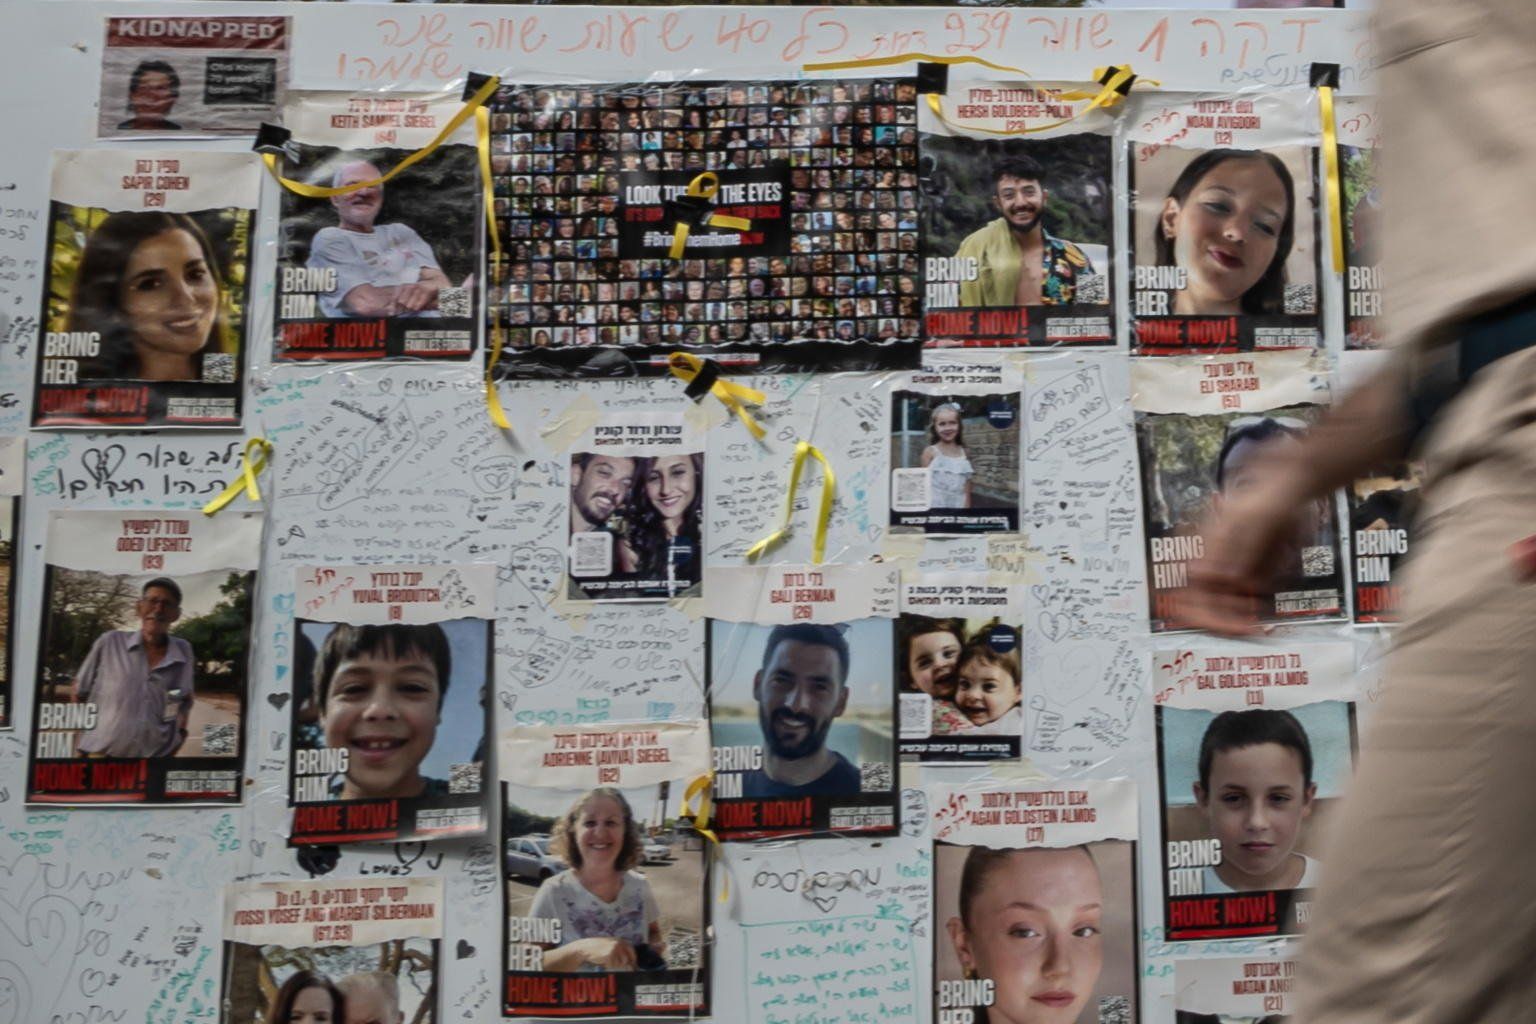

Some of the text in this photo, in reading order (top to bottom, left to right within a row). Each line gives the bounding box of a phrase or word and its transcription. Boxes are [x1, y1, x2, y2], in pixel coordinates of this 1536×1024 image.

[117, 20, 277, 41] KIDNAPPED
[716, 15, 771, 53] 40
[331, 115, 360, 129] KEITH
[957, 105, 1073, 119] HERSH GOLDBERG-POLIN
[1186, 116, 1214, 129] NOAM
[122, 176, 190, 190] SAPIR COHEN
[625, 182, 782, 205] LOOK THE THE EYES
[280, 267, 337, 293] BRING
[925, 257, 979, 282] BRING
[1135, 266, 1187, 290] BRING
[280, 294, 316, 319] HIM
[925, 283, 960, 308] HIM
[1135, 291, 1168, 316] HER
[332, 319, 387, 349] NOW!
[979, 308, 1029, 337] NOW!
[1189, 317, 1239, 344] NOW!
[44, 332, 100, 358] BRING
[41, 359, 78, 384] HER
[1200, 377, 1260, 393] ELI SHARABI
[117, 537, 192, 552] ODED LIFSHITZ
[1151, 536, 1204, 562] BRING
[1356, 529, 1408, 556] BRING
[1154, 563, 1188, 589] HIM
[1356, 557, 1390, 582] HIM
[353, 589, 384, 603] YUVAL
[771, 589, 835, 604] GALI BERMAN
[1358, 587, 1400, 612] HOM
[1198, 671, 1309, 690] GAL GOLDSTEIN ALMOG
[39, 703, 98, 729] BRING
[36, 732, 75, 758] HIM
[542, 751, 594, 767] ADRIENNE
[637, 748, 671, 764] SIEGEL
[295, 748, 349, 775] BRING
[713, 746, 763, 771] BRING
[295, 777, 331, 802] HIM
[347, 801, 399, 830] NOW!
[763, 798, 812, 826] NOW!
[970, 808, 1096, 825] AGAM GOLDSTEIN ALMOG
[1168, 838, 1222, 868] BRING
[1168, 869, 1206, 895] HIM
[269, 908, 301, 924] YOSEF
[372, 903, 435, 920] SILBERMAN
[1169, 893, 1277, 926] HOME NOW!
[509, 917, 562, 944] BRING
[508, 944, 545, 972] HER
[508, 974, 617, 1004] HOME NOW!
[939, 980, 995, 1007] BRING
